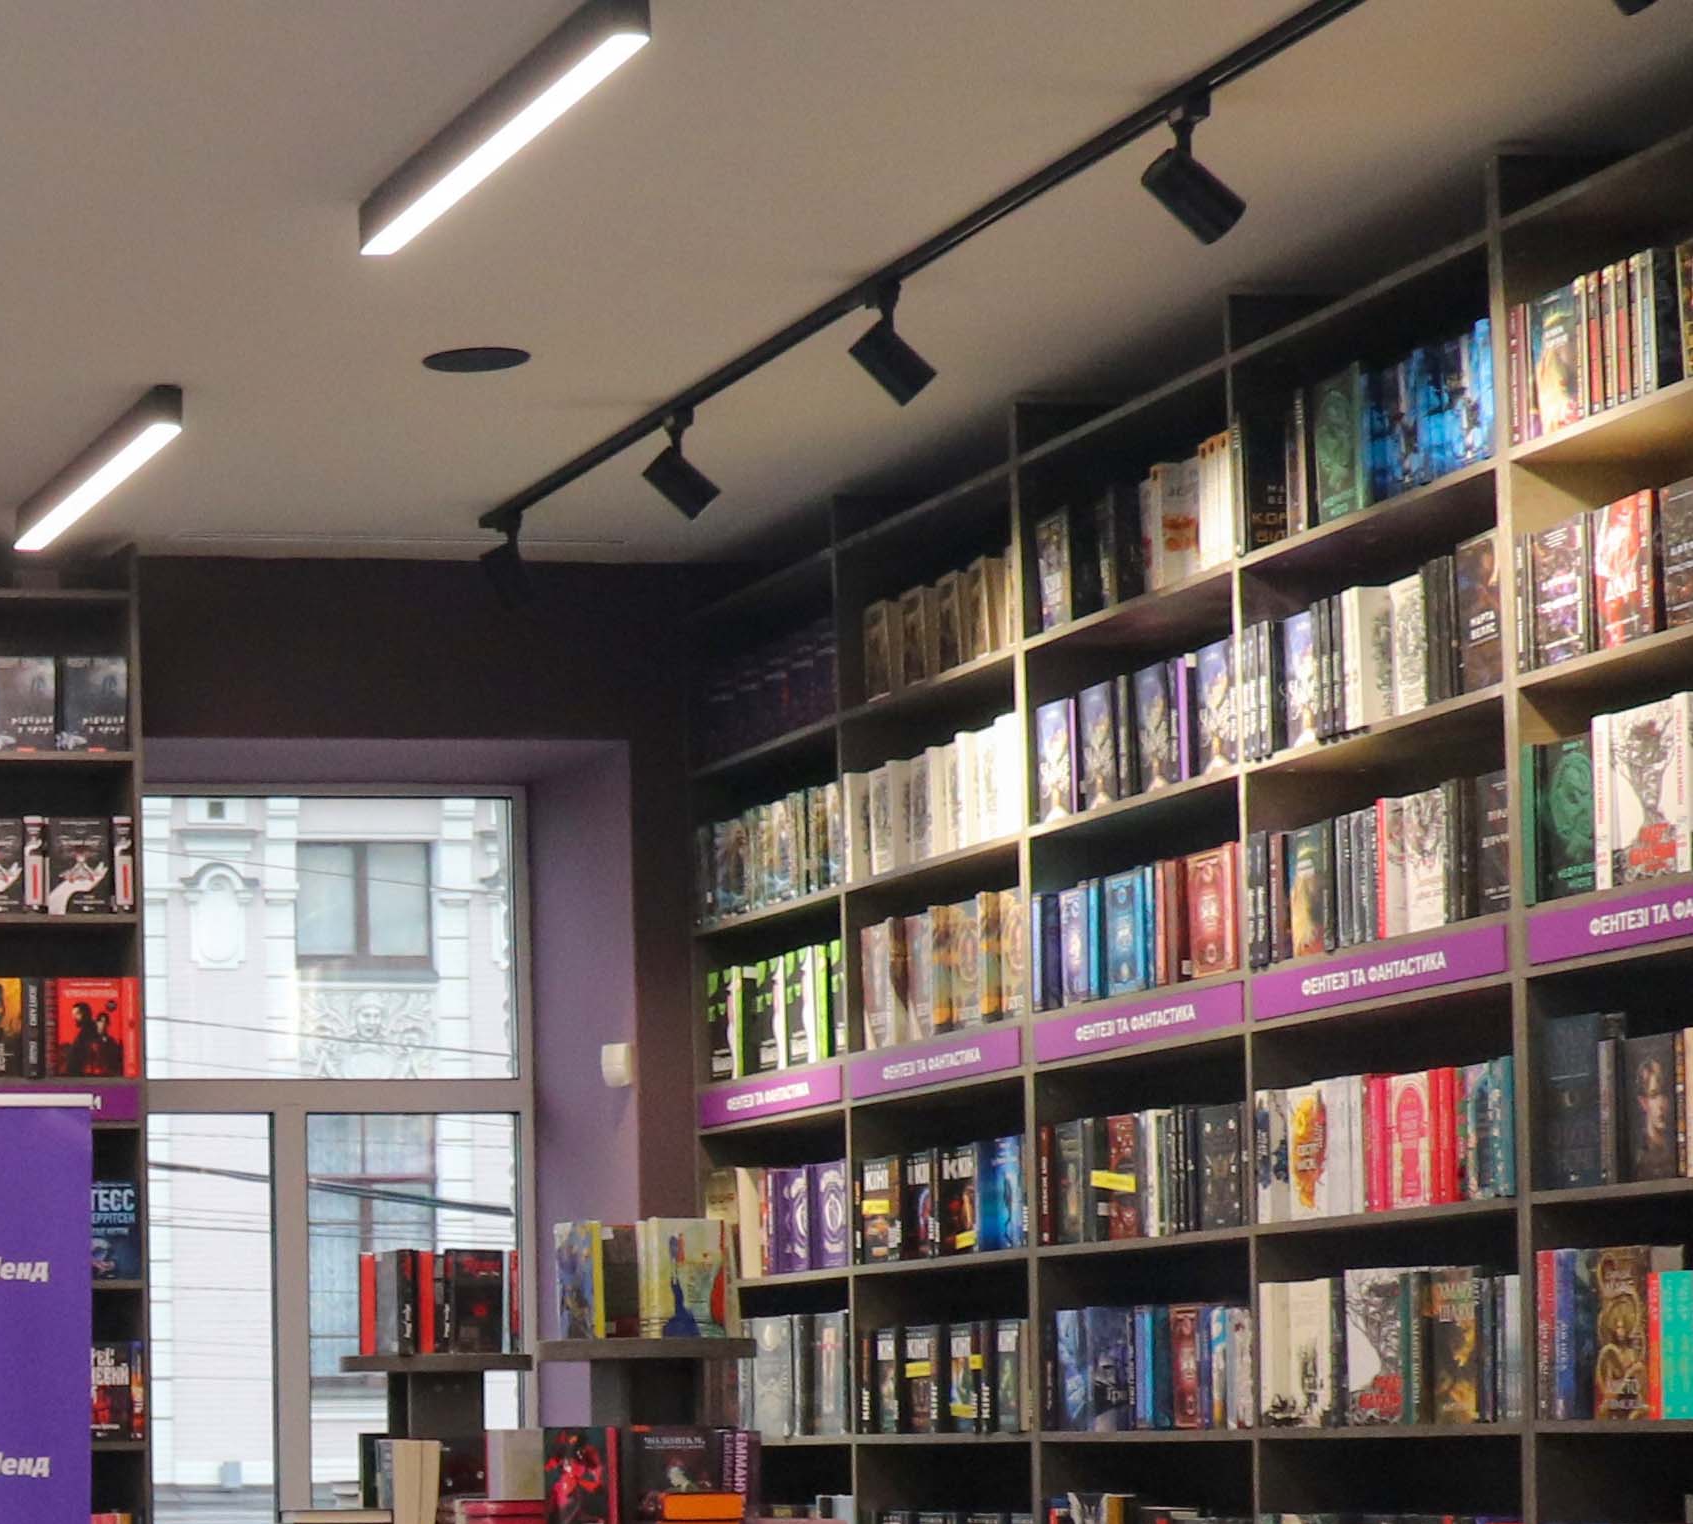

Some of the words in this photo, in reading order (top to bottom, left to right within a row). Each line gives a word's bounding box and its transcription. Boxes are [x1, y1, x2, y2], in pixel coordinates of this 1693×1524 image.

[1588, 908, 1649, 937] ФЕНТЕЗІ
[1651, 903, 1670, 924] ТА
[1301, 973, 1350, 996] ФЕНТЕЗІ
[1350, 969, 1367, 986] ТА
[1367, 951, 1447, 983] ФАНТАСТИКА
[1075, 1020, 1116, 1043] ФЕНТЕЗІ
[1116, 1017, 1131, 1034] ТА
[1130, 1003, 1196, 1033] ФАНТАСТИКА
[882, 1064, 916, 1081] ФЕНТЕЗІ
[917, 1060, 927, 1075] ТА
[927, 1047, 982, 1072] ФАНТАСТИКА
